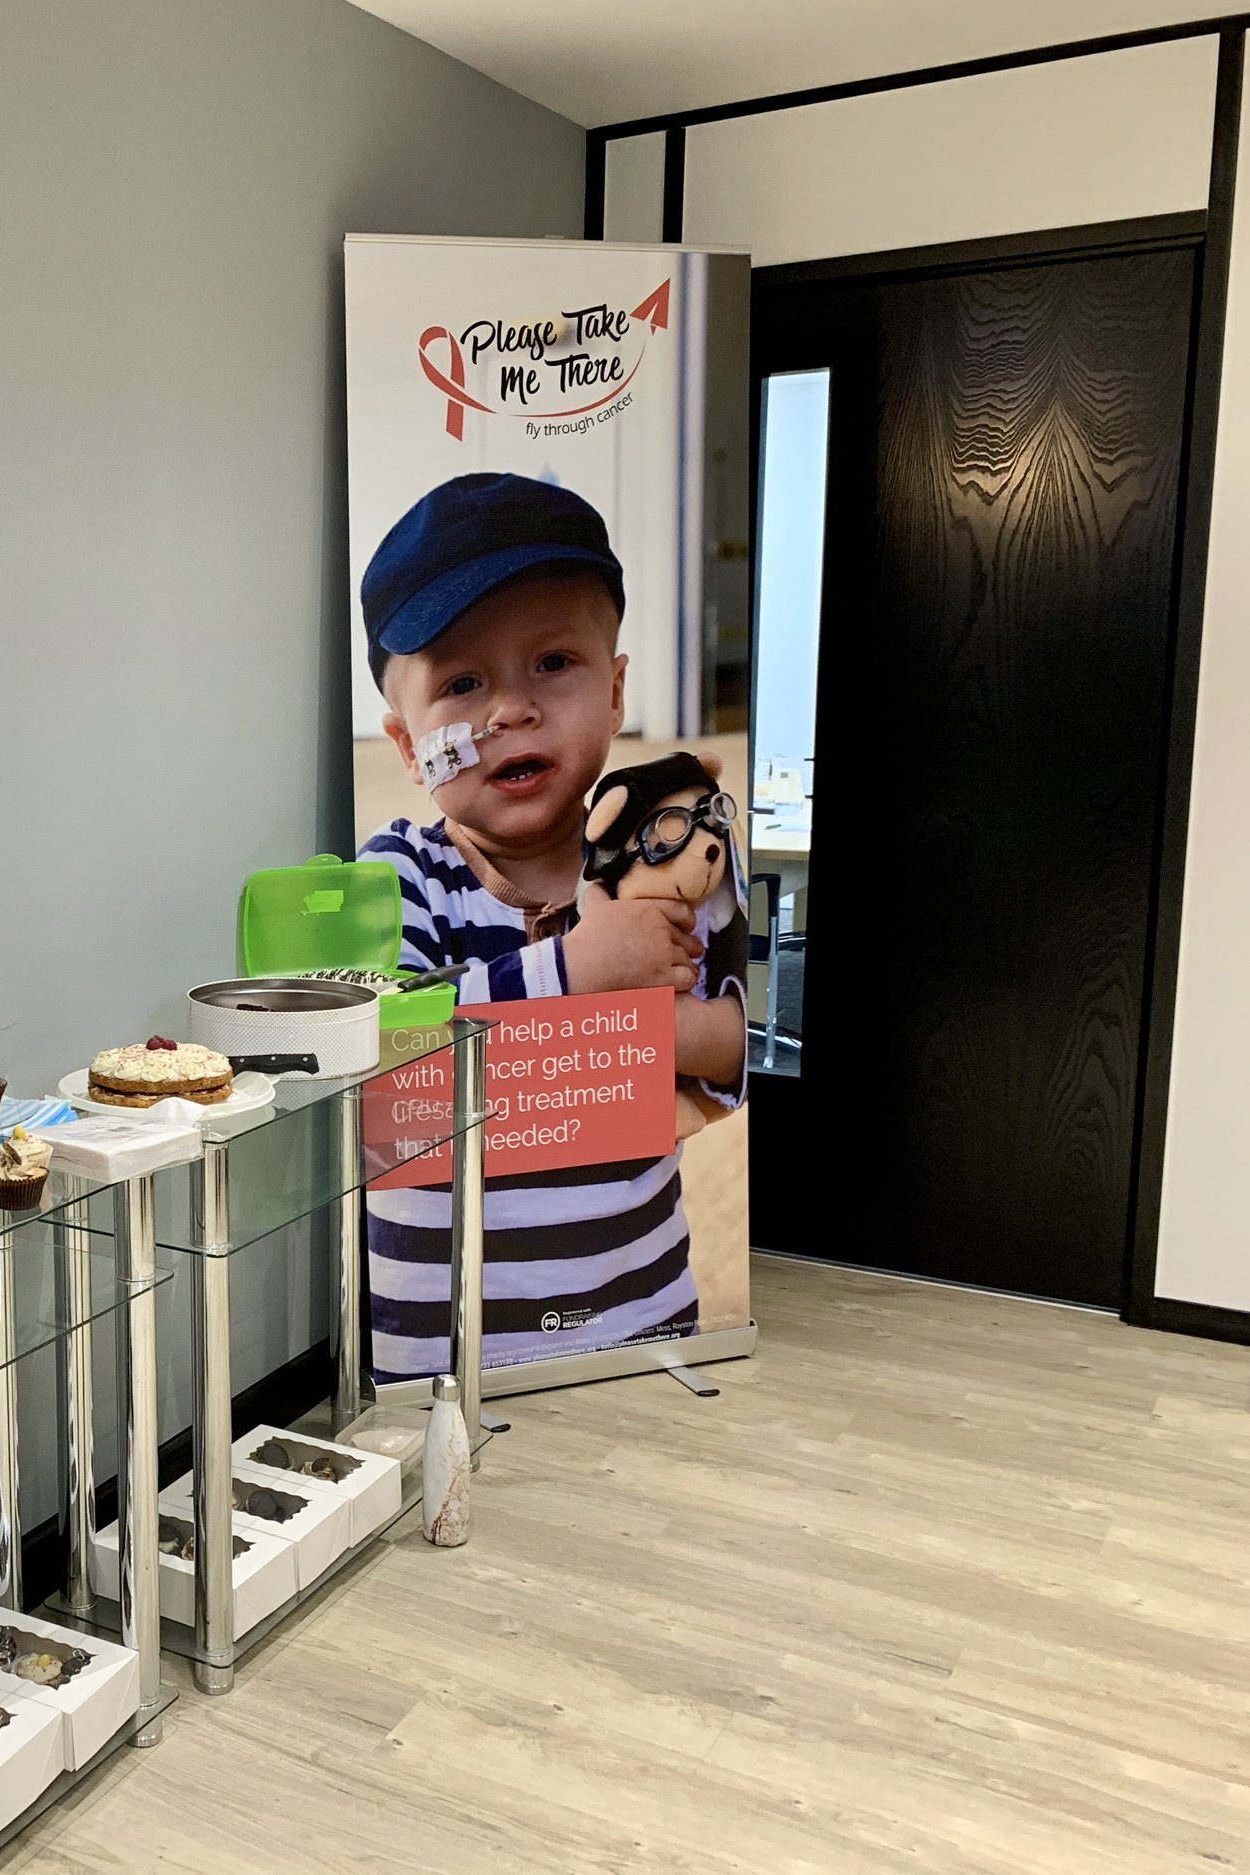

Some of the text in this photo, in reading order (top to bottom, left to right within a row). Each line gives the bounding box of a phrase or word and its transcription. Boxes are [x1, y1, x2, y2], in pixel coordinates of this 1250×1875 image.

[460, 304, 629, 364] Please Take
[500, 353, 624, 405] Me There
[526, 392, 634, 440] fly through cancer
[391, 1028, 440, 1052] Can
[500, 1018, 553, 1046] help
[560, 1020, 574, 1038] a
[580, 1008, 638, 1035] child
[392, 1063, 444, 1090] with
[542, 1053, 583, 1079] get
[588, 1047, 612, 1068] to
[618, 1042, 657, 1065] the
[518, 1079, 635, 1112] treatment
[394, 1133, 443, 1160] that
[485, 1119, 581, 1151] eeded?
[544, 1317, 558, 1328] FR
[562, 1317, 603, 1328] REGULATOR
